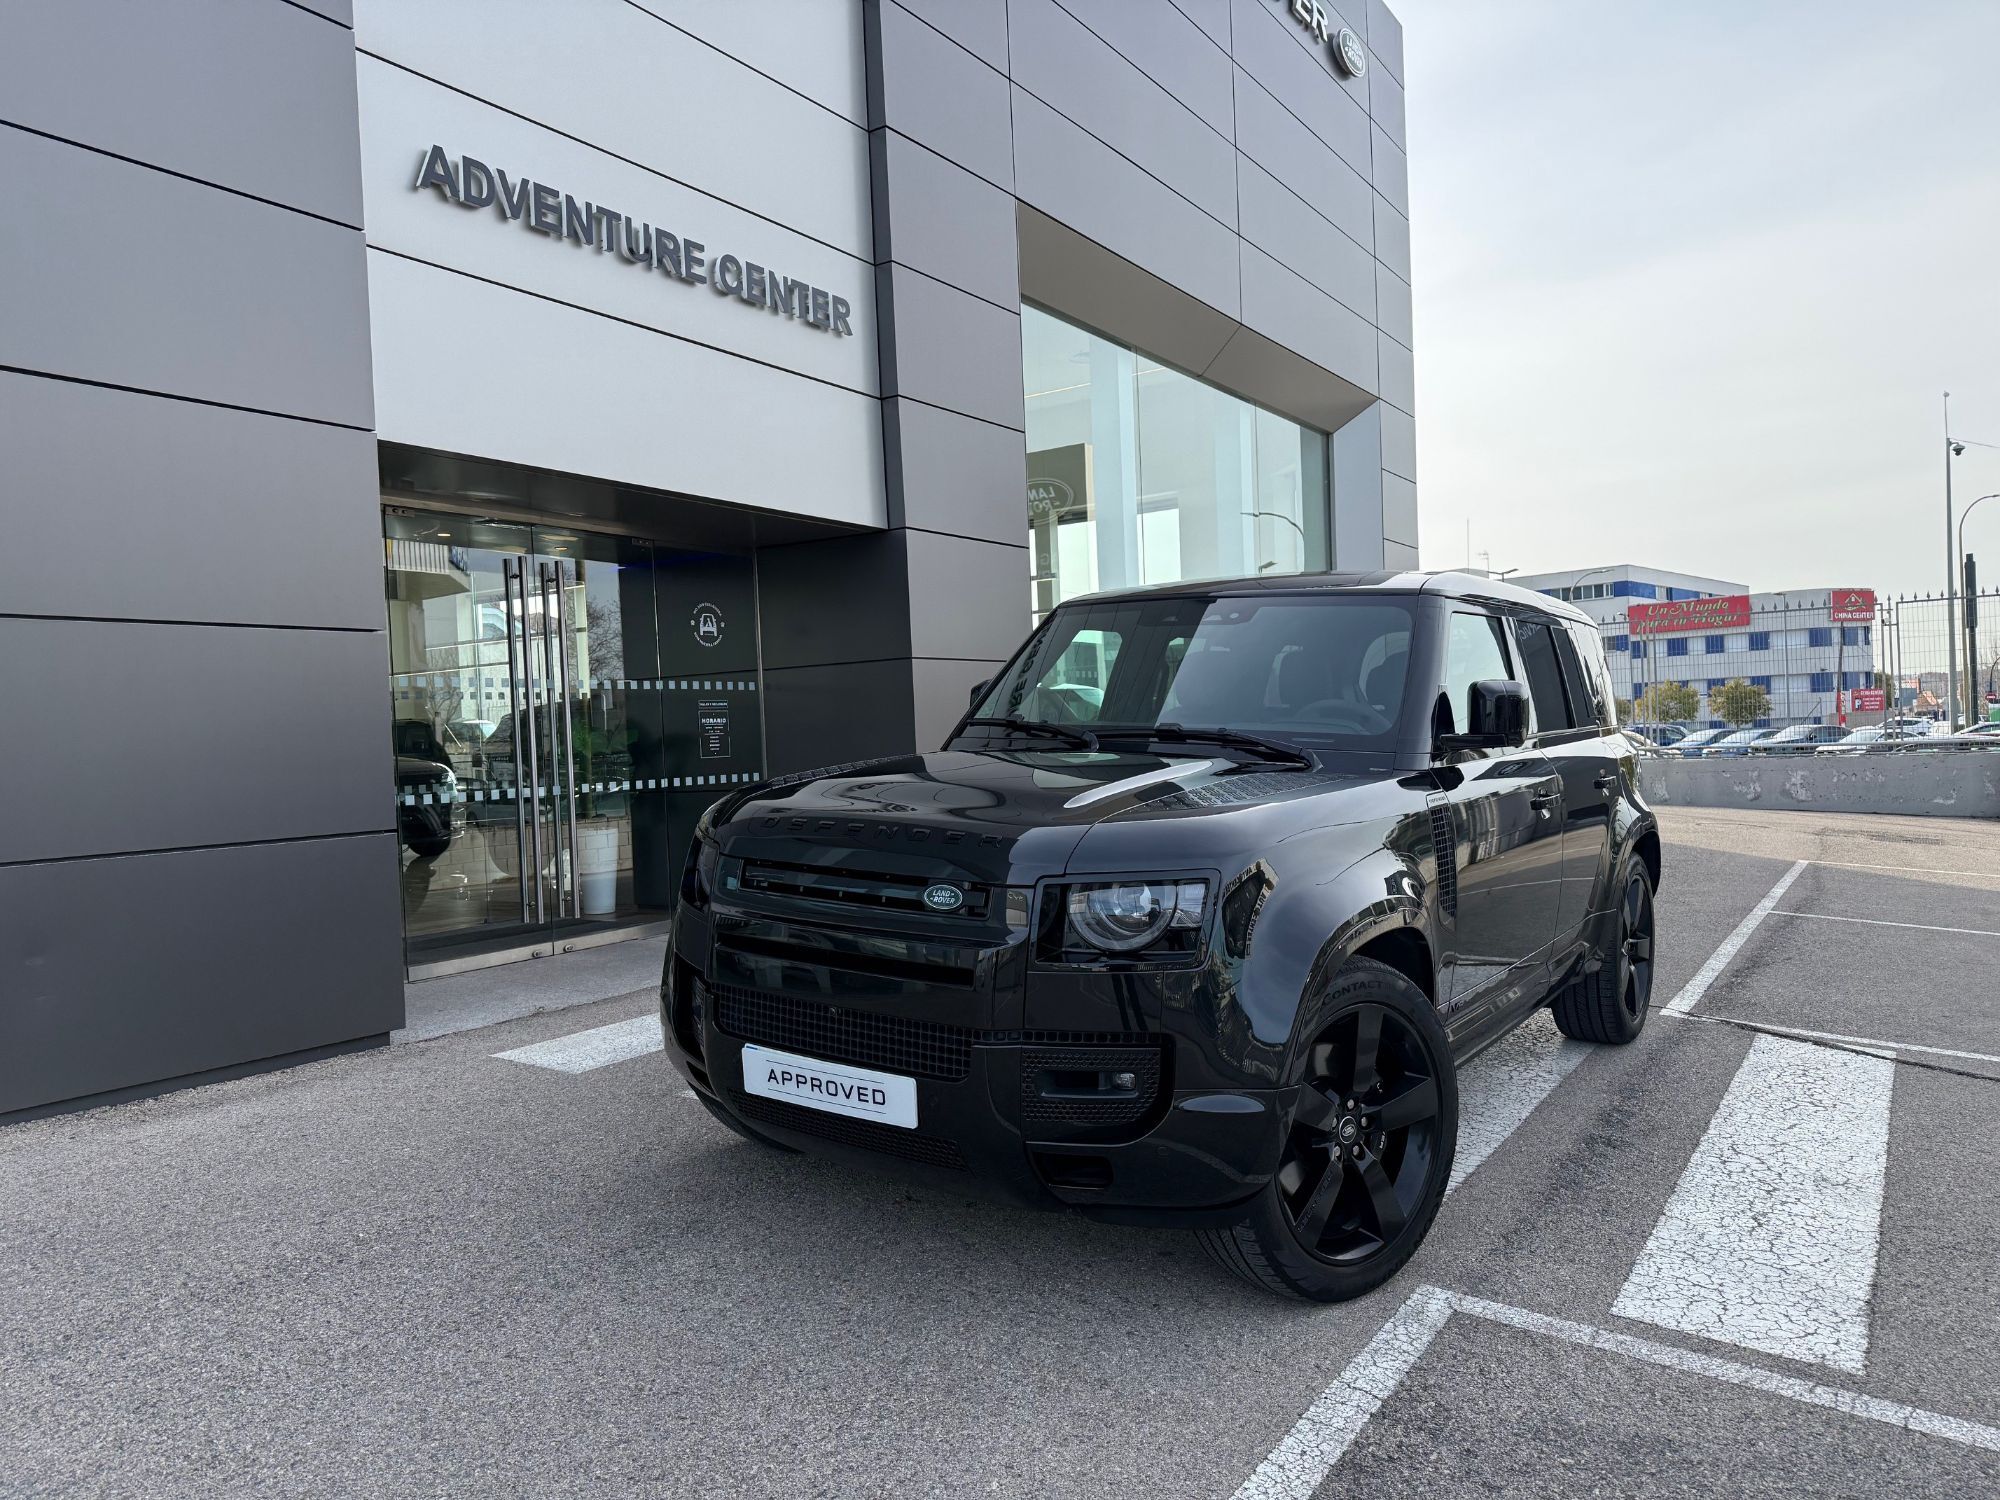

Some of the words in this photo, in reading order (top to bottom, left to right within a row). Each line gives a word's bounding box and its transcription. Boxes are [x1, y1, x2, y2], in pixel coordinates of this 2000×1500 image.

[1295, 0, 1329, 42] ER
[415, 143, 707, 286] ADVENTURE
[714, 253, 853, 337] CENTER
[1648, 604, 1667, 616] Un
[1669, 599, 1729, 615] Mundo
[1834, 611, 1852, 619] CHINA
[1852, 611, 1874, 619] CENTER
[762, 816, 1005, 849] DEFENDER
[1322, 980, 1384, 1006] CONTACT
[767, 1067, 887, 1106] APPROVED
